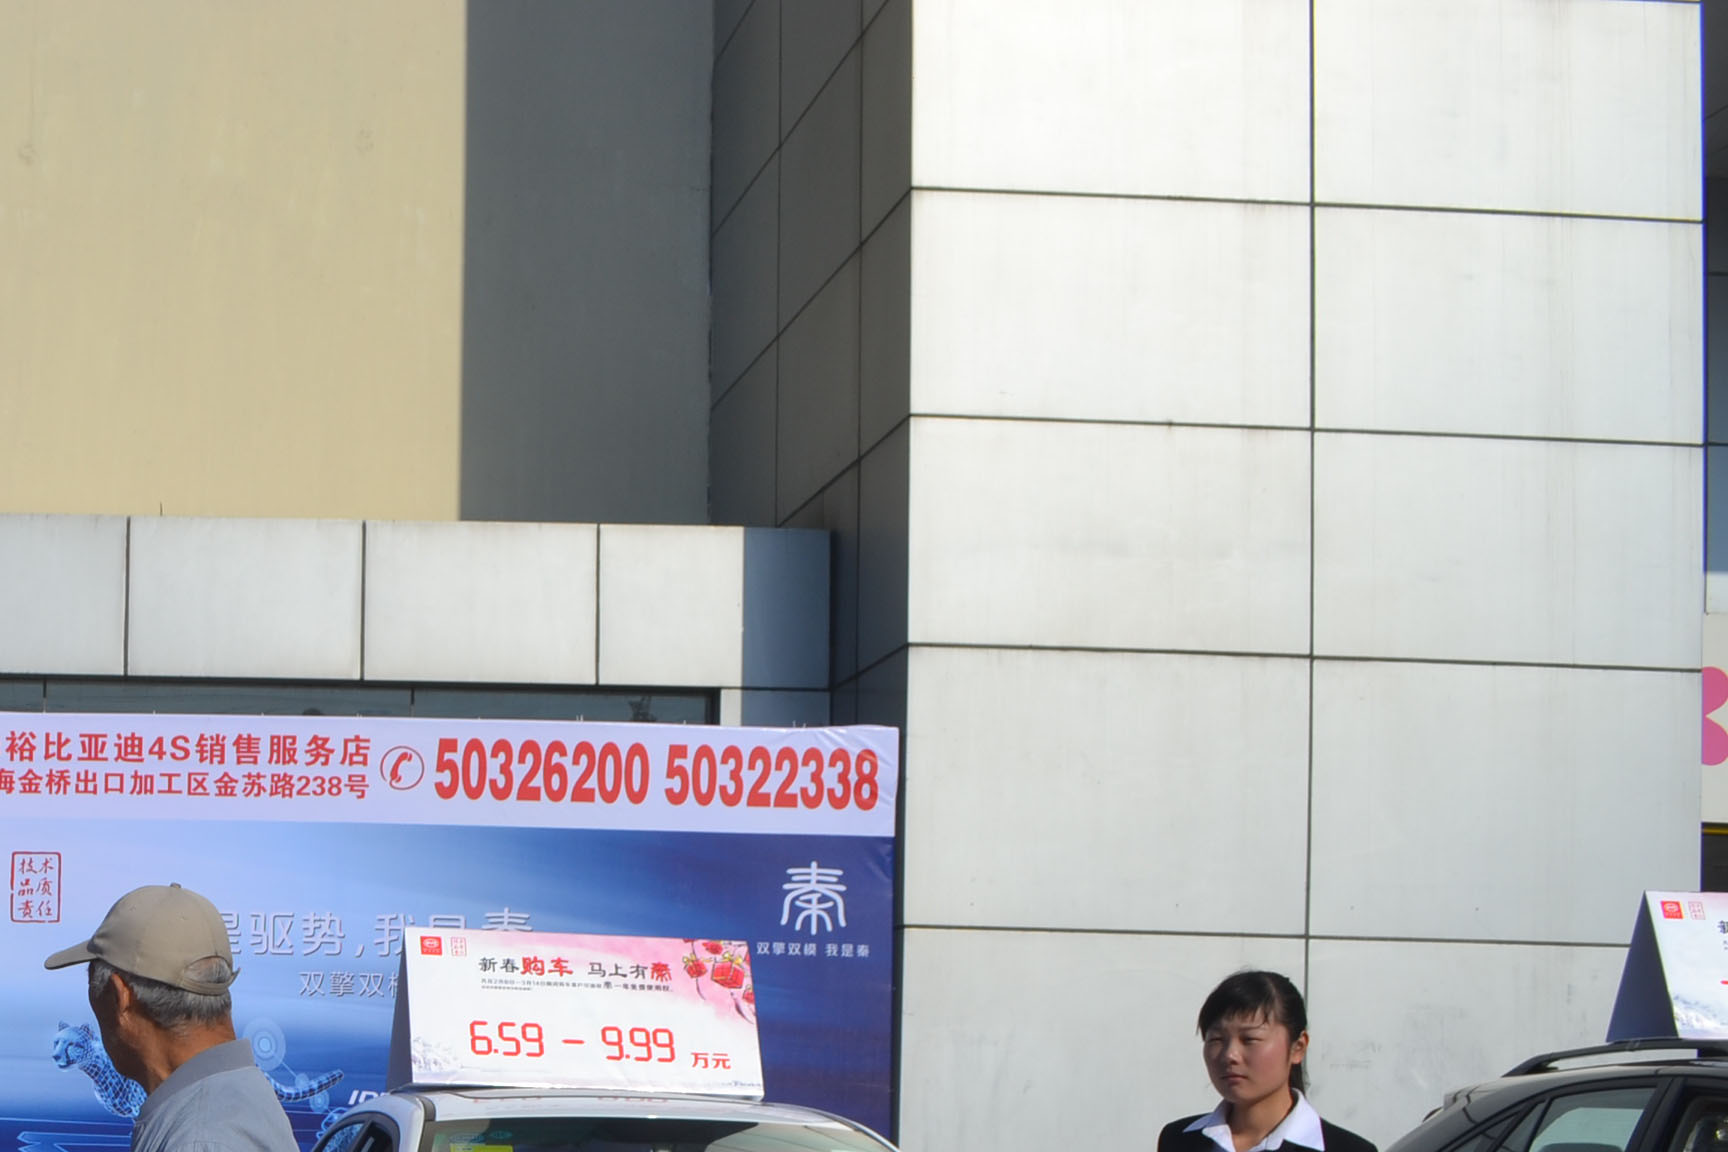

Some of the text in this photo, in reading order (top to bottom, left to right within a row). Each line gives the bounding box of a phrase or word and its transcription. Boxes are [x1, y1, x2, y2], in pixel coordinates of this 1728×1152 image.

[433, 737, 880, 812] 50326200 50322338
[478, 955, 574, 978] 新春购车
[469, 1020, 545, 1058] 6.59
[600, 1025, 676, 1063] 9.99
[690, 1052, 732, 1070] 万元
